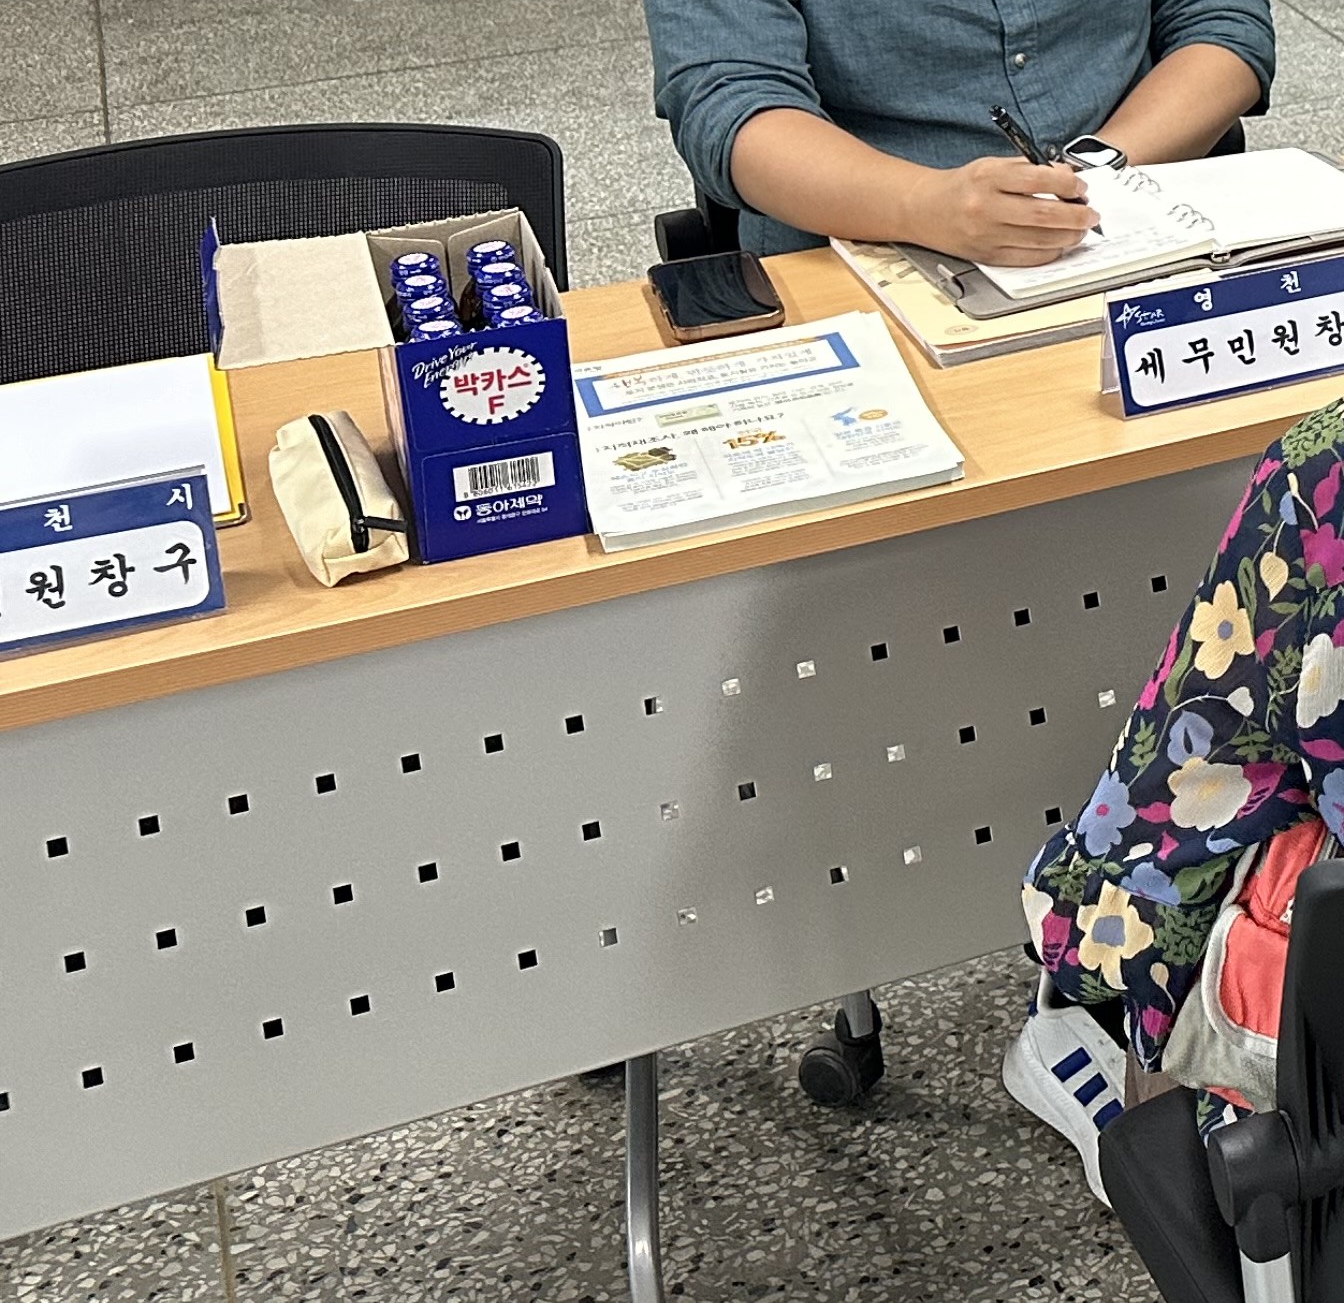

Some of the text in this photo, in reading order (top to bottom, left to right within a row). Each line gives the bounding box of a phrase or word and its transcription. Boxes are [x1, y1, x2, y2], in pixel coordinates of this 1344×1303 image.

[411, 341, 478, 380] Drive Your
[453, 365, 532, 396] 박카스
[488, 395, 505, 415] F
[722, 430, 787, 450] 15%
[475, 494, 543, 517] 동아제약
[0, 542, 197, 619] 원창구
